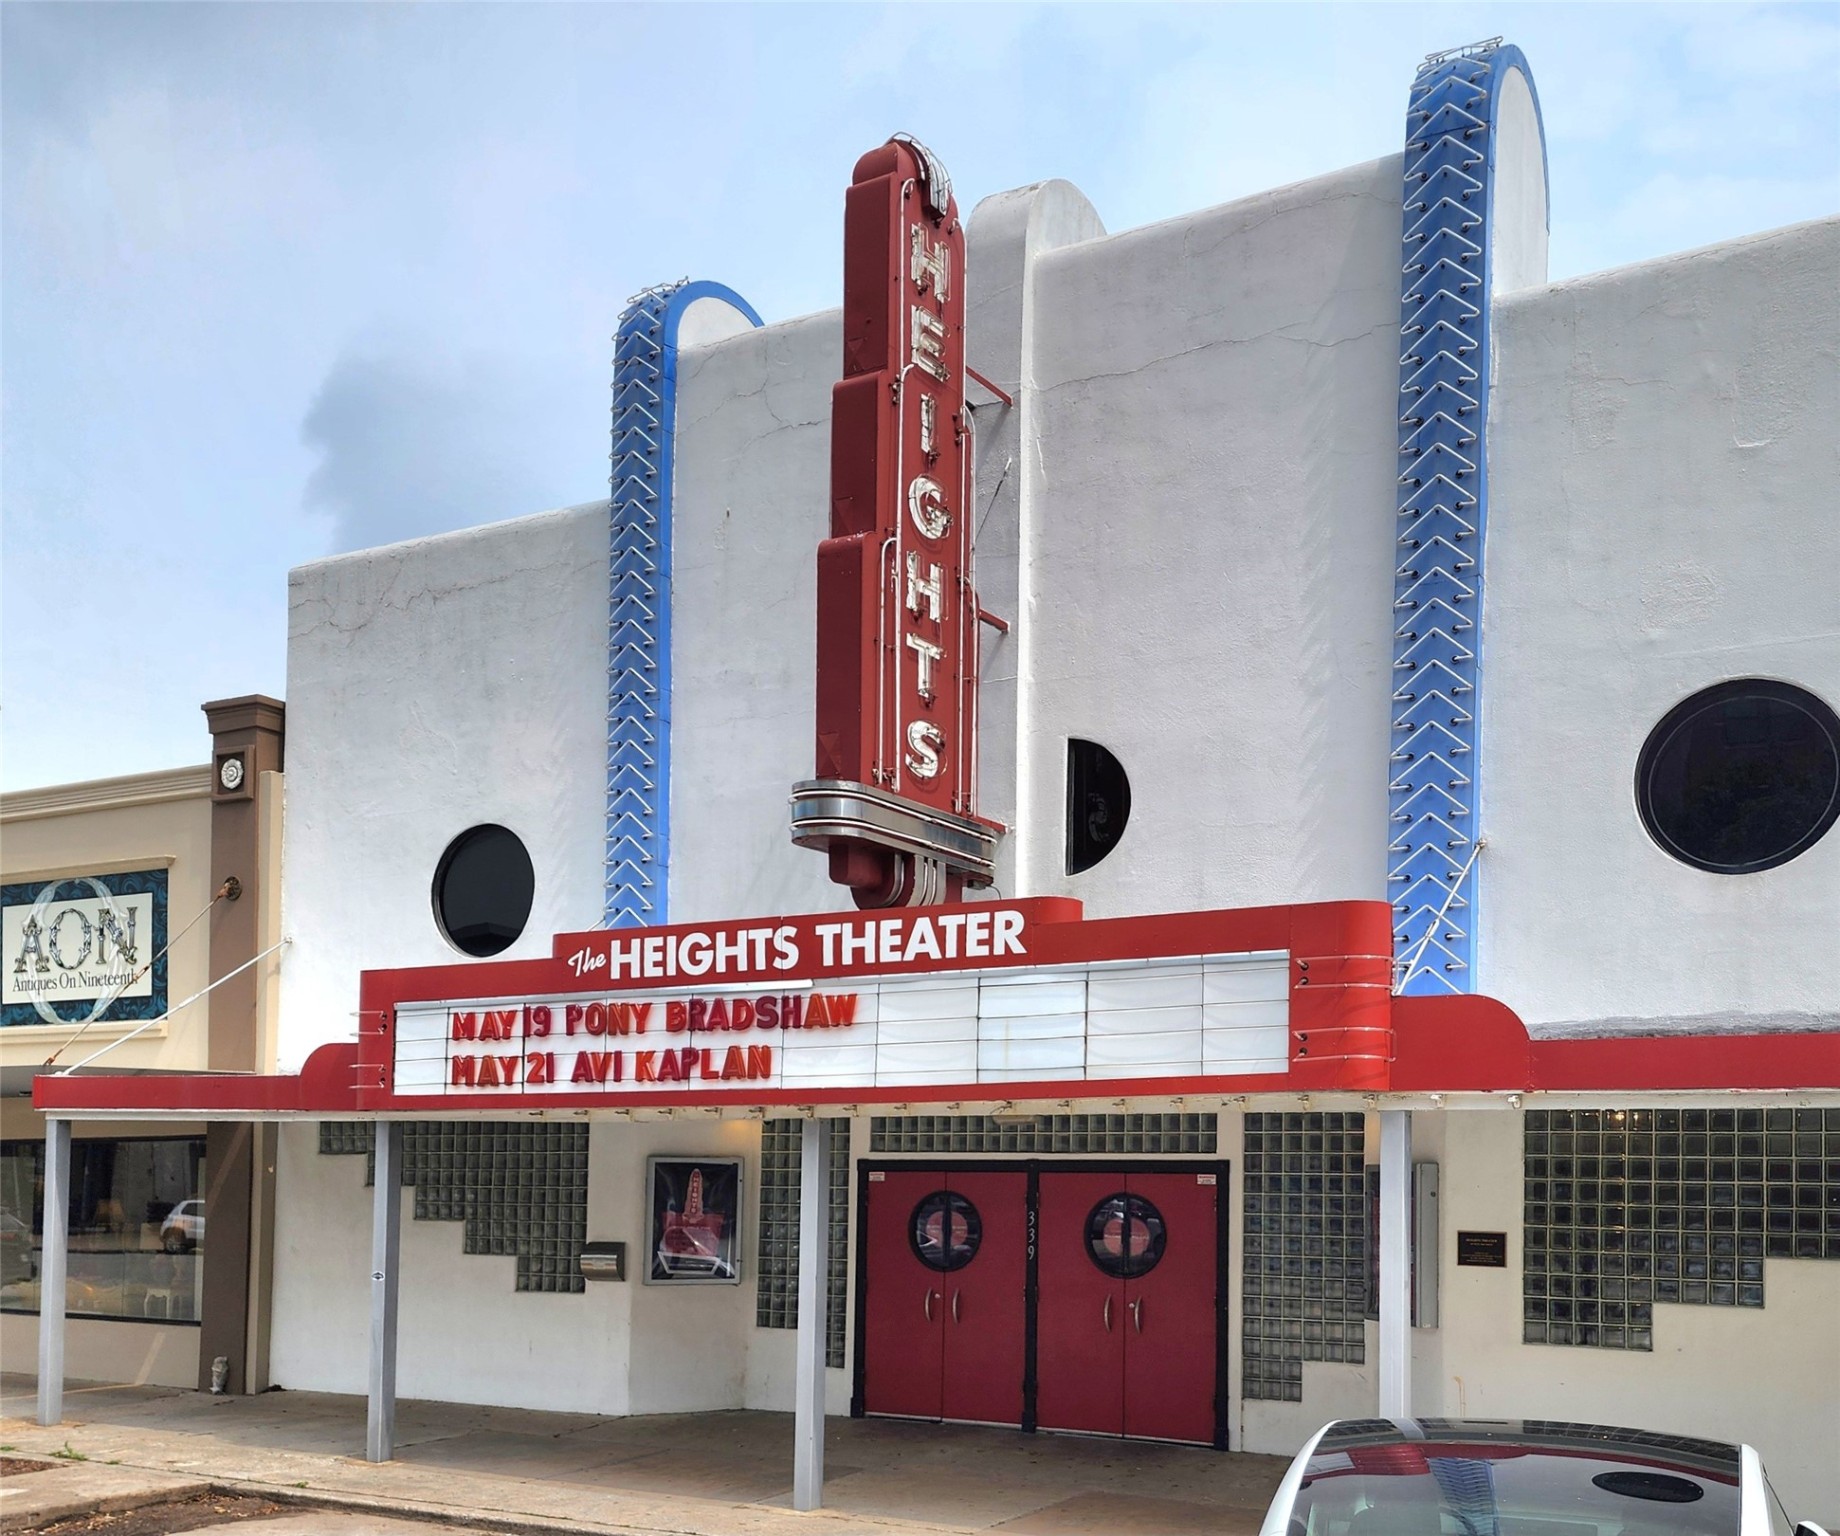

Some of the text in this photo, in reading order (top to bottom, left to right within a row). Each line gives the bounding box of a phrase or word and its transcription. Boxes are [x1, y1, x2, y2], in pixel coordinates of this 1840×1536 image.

[904, 221, 953, 780] HEIGHTS
[14, 907, 138, 973] AON
[567, 910, 1027, 980] The HEIGHTS THEATER
[13, 969, 138, 995] Antiques On Nineteenth
[451, 993, 858, 1041] MAY 19 PONY BRADSHAW
[451, 1045, 772, 1087] MAY 21 AVI KAPLAN
